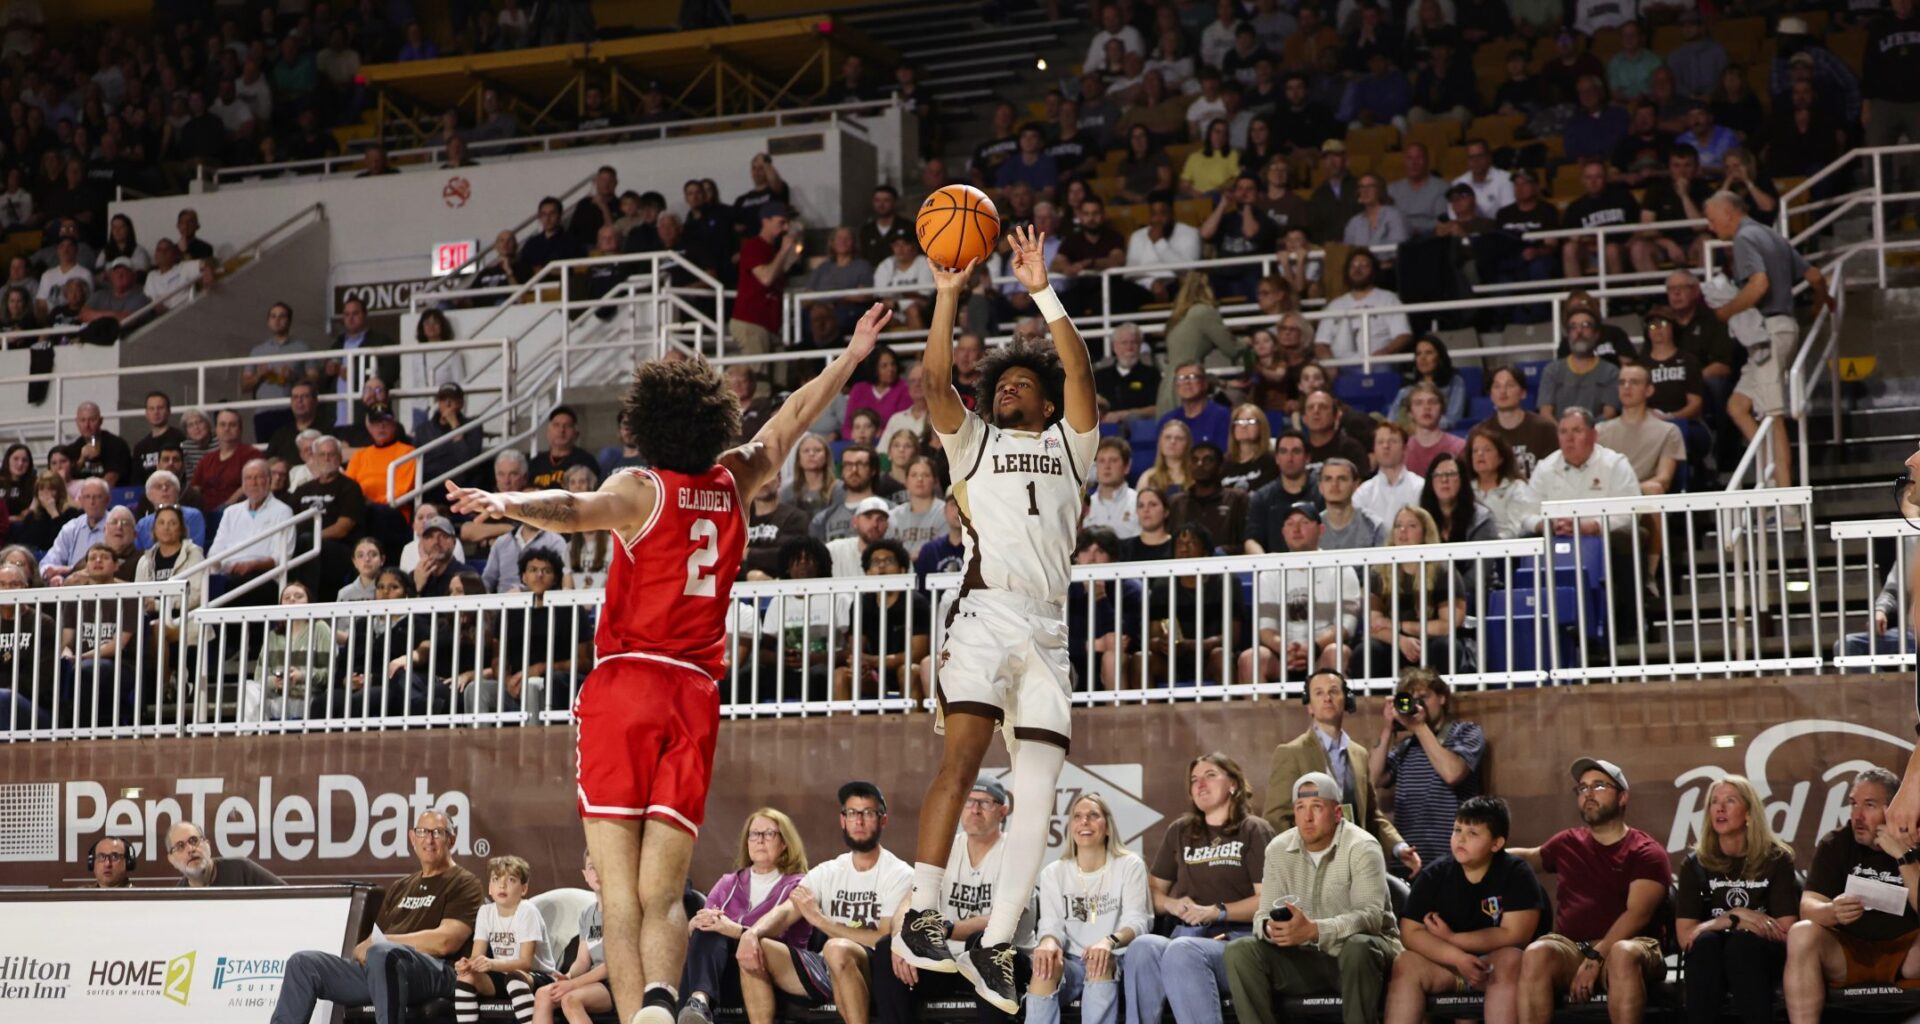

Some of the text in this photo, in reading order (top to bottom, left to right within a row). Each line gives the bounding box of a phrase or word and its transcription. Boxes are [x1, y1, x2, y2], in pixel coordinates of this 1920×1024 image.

[439, 243, 469, 271] EXIT
[1846, 360, 1858, 377] A
[993, 454, 1062, 475] LEHIGH
[678, 487, 731, 513] GLADDEN
[1027, 481, 1040, 515] 1
[683, 518, 719, 597] 2
[66, 774, 471, 862] PenTeleData
[1184, 841, 1244, 861] LEHIGH
[836, 890, 877, 902] CLUTCH
[0, 956, 71, 980] Hilton
[227, 959, 284, 974] STAYBRI
[88, 957, 191, 998] HOME 2
[33, 982, 66, 999] Inn
[132, 989, 161, 997] HILTON
[237, 984, 274, 992] SUIT
[228, 998, 243, 1007] AN
[245, 998, 264, 1007] IHG
[927, 1001, 956, 1009] MOUNTAIN
